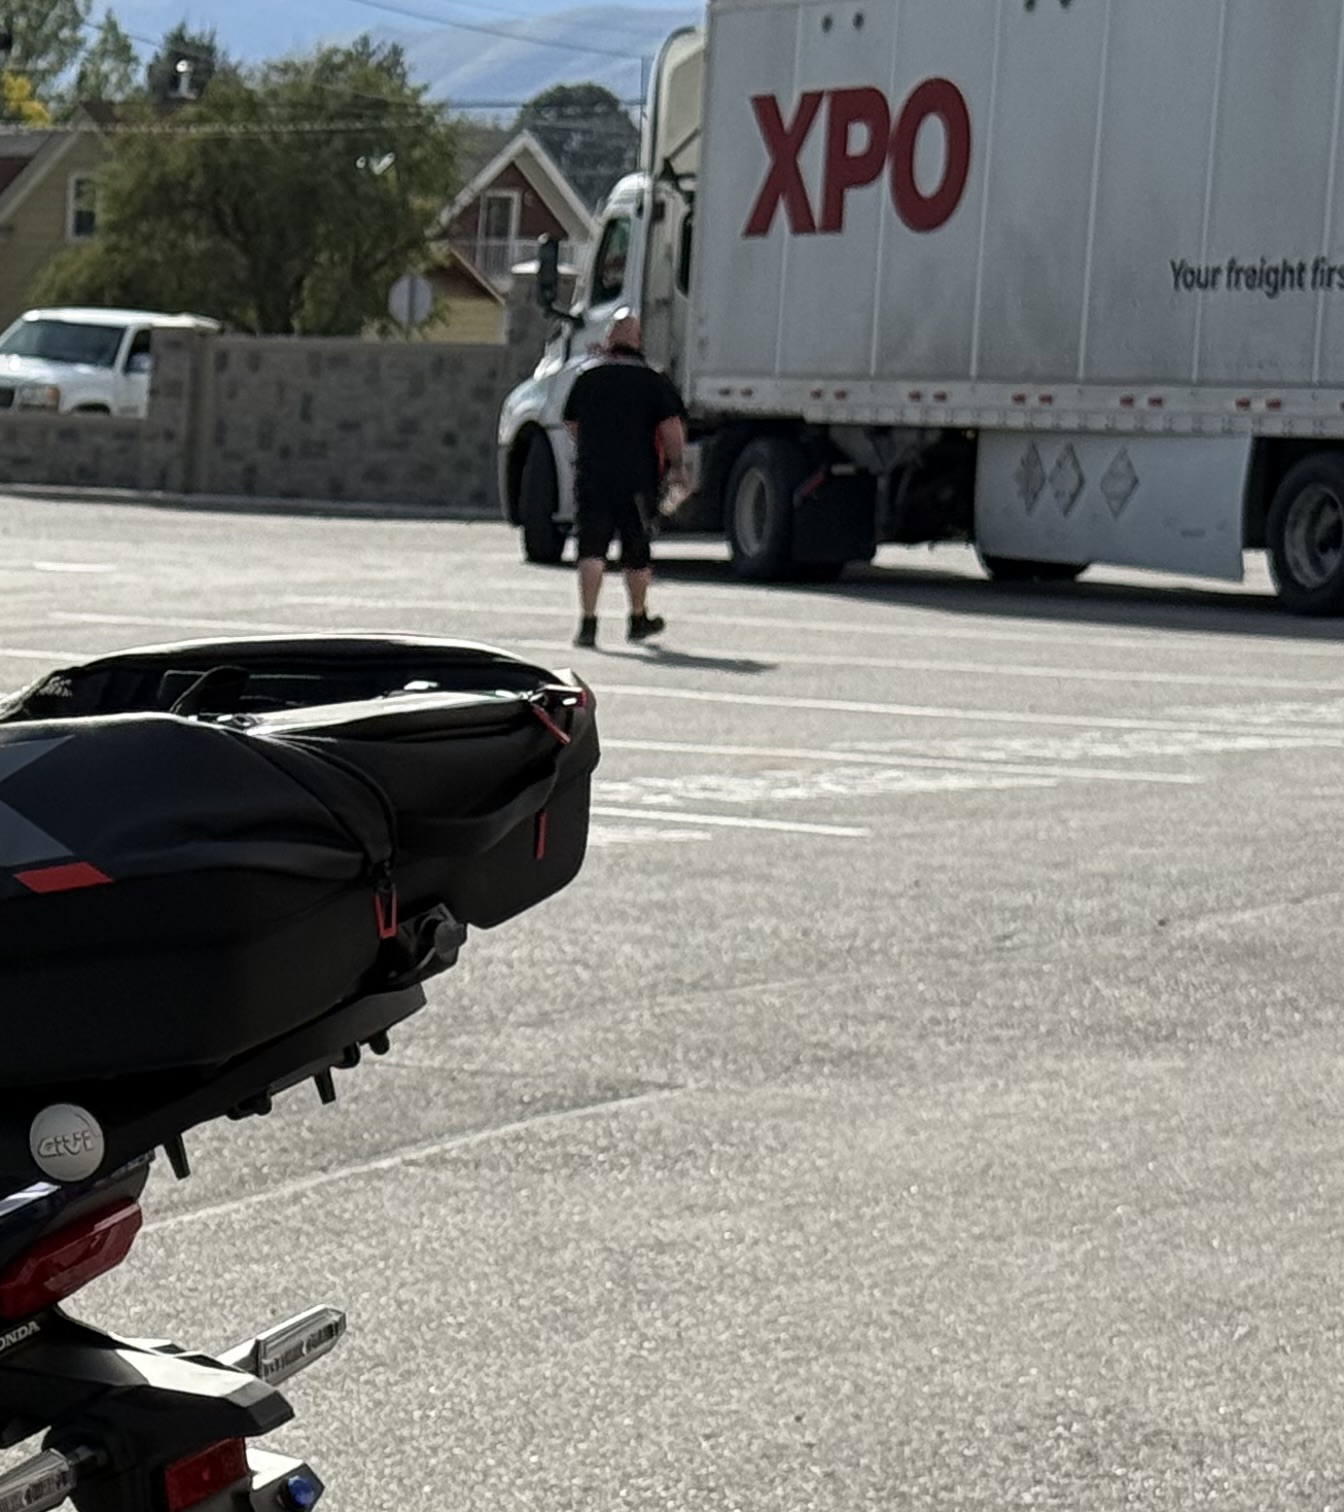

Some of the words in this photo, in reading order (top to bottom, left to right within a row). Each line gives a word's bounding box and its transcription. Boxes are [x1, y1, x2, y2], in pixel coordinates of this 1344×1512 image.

[742, 77, 972, 238] XPO
[1170, 257, 1223, 291] Your
[1226, 255, 1306, 299] freight
